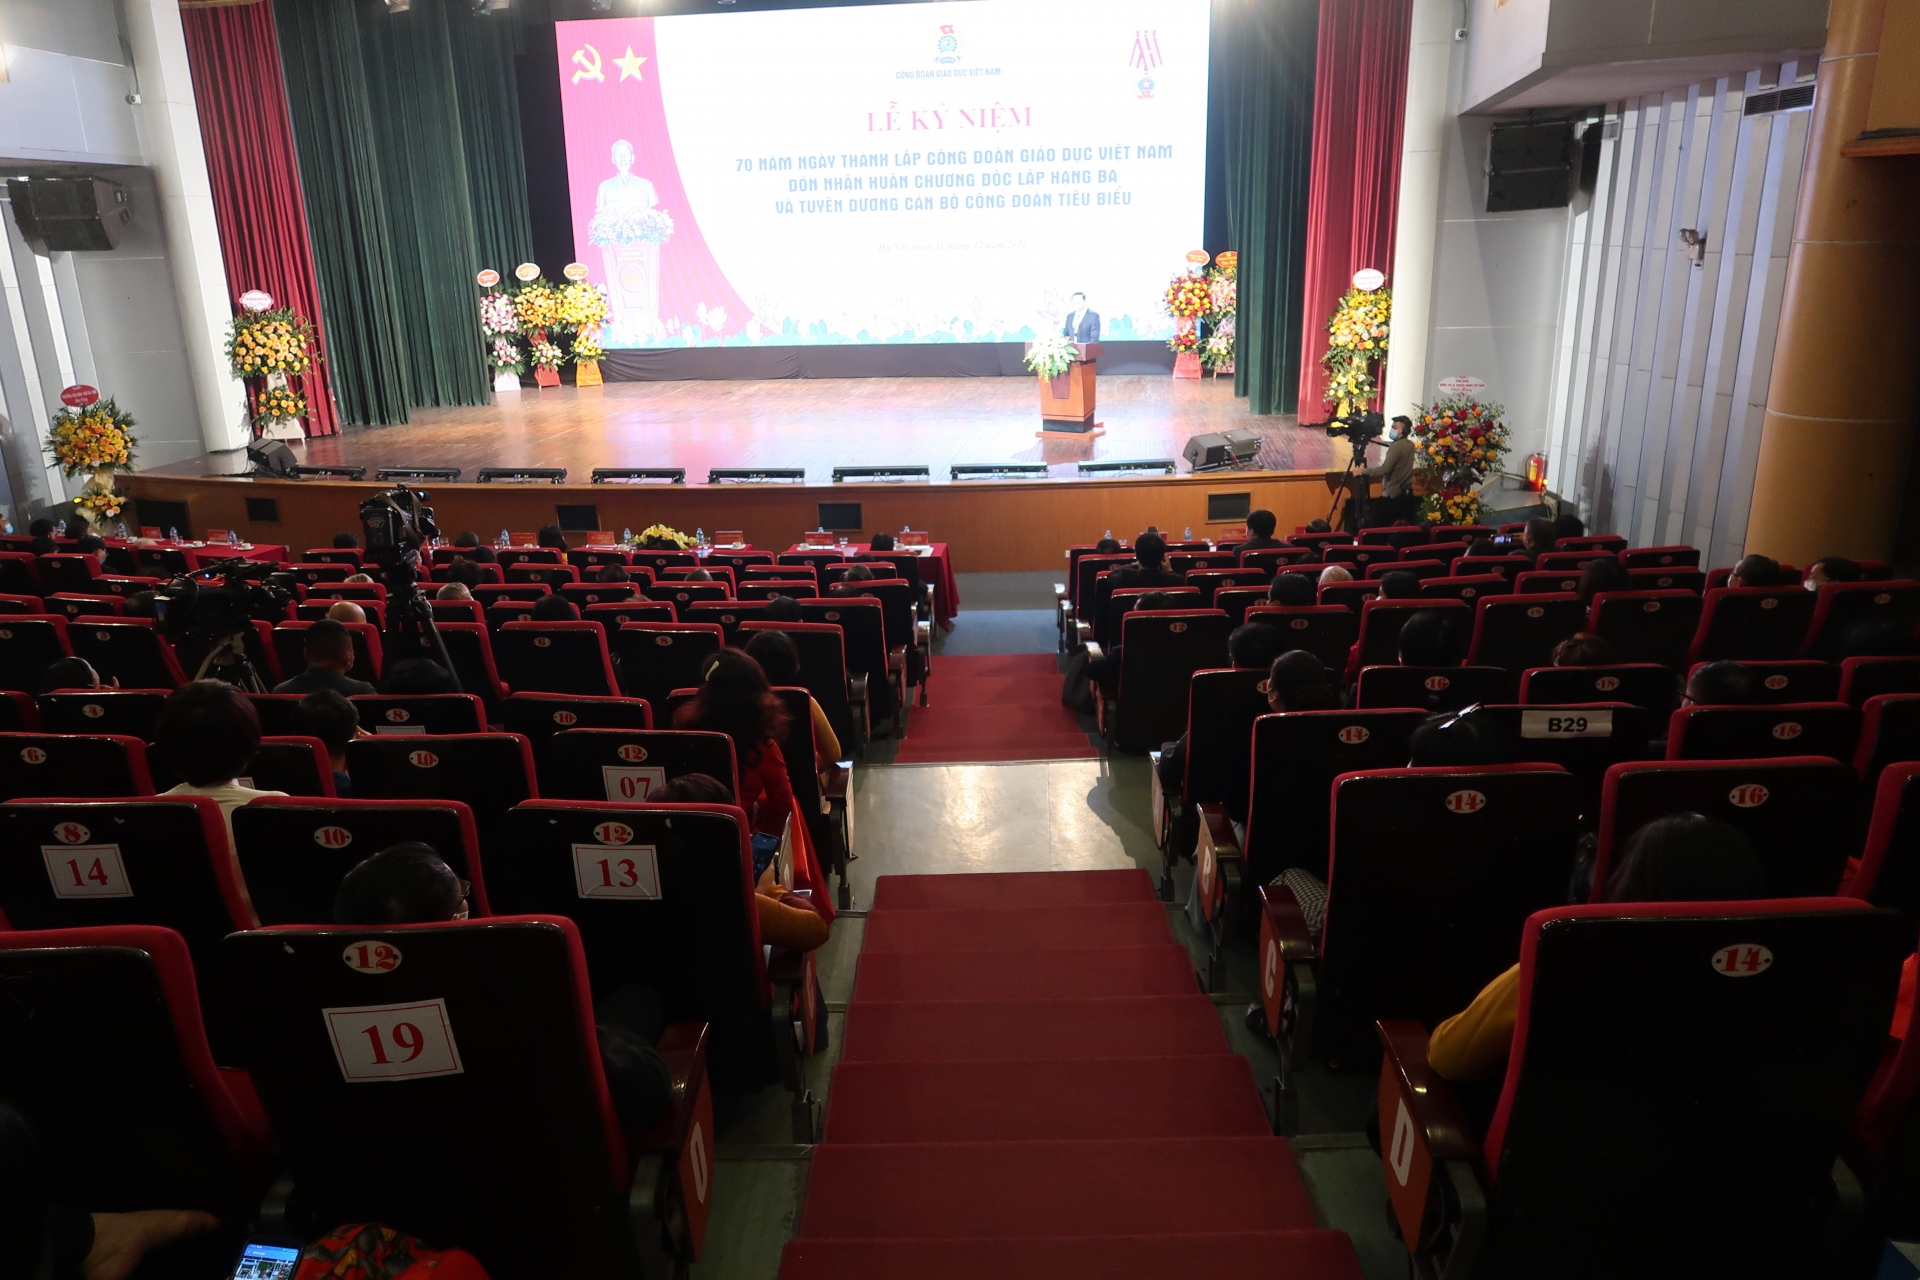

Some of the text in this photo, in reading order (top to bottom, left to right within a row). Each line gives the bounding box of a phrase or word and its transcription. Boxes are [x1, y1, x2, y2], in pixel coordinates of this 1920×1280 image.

[895, 66, 1002, 80] CÔNG ĐOÀN GIÁO DỤC VIỆT NAM
[868, 101, 1032, 133] LỄ KỶ NIỆM
[736, 143, 1173, 173] 70 NĂM NGÀY THÀNH LẬP CÔNG ĐOÀN GIÁO DỤC VIỆT NAM
[788, 169, 1118, 193] ĐÓN NHẬN HUÂN CHƯƠNG ĐỘC LẬP HẠNG BA
[776, 186, 1132, 215] VÀ TUYÊN DƯƠNG CÁN BỘ CÔNG ĐOÀN TIÊU BIỂU
[1530, 608, 1541, 616] 18
[1173, 623, 1184, 631] 12
[1430, 678, 1446, 688] 16
[1601, 679, 1615, 688] 18
[1768, 677, 1784, 687] 20
[392, 709, 404, 722] 8
[558, 712, 573, 724] 10
[1547, 717, 1588, 733] B29
[1779, 724, 1798, 738] 18
[1345, 727, 1365, 742] 14
[27, 750, 38, 762] 6
[416, 752, 433, 765] 10
[623, 747, 644, 759] 12
[620, 776, 651, 799] 07
[1734, 786, 1764, 804] 16
[1451, 793, 1480, 811] 14
[64, 825, 82, 842] 8
[322, 828, 347, 845] 10
[600, 825, 627, 843] 12
[66, 858, 108, 887] 14
[597, 858, 639, 888] 13
[354, 944, 397, 970] 12
[1720, 947, 1763, 973] 14
[361, 1022, 425, 1065] 19
[1389, 1097, 1415, 1187] D
